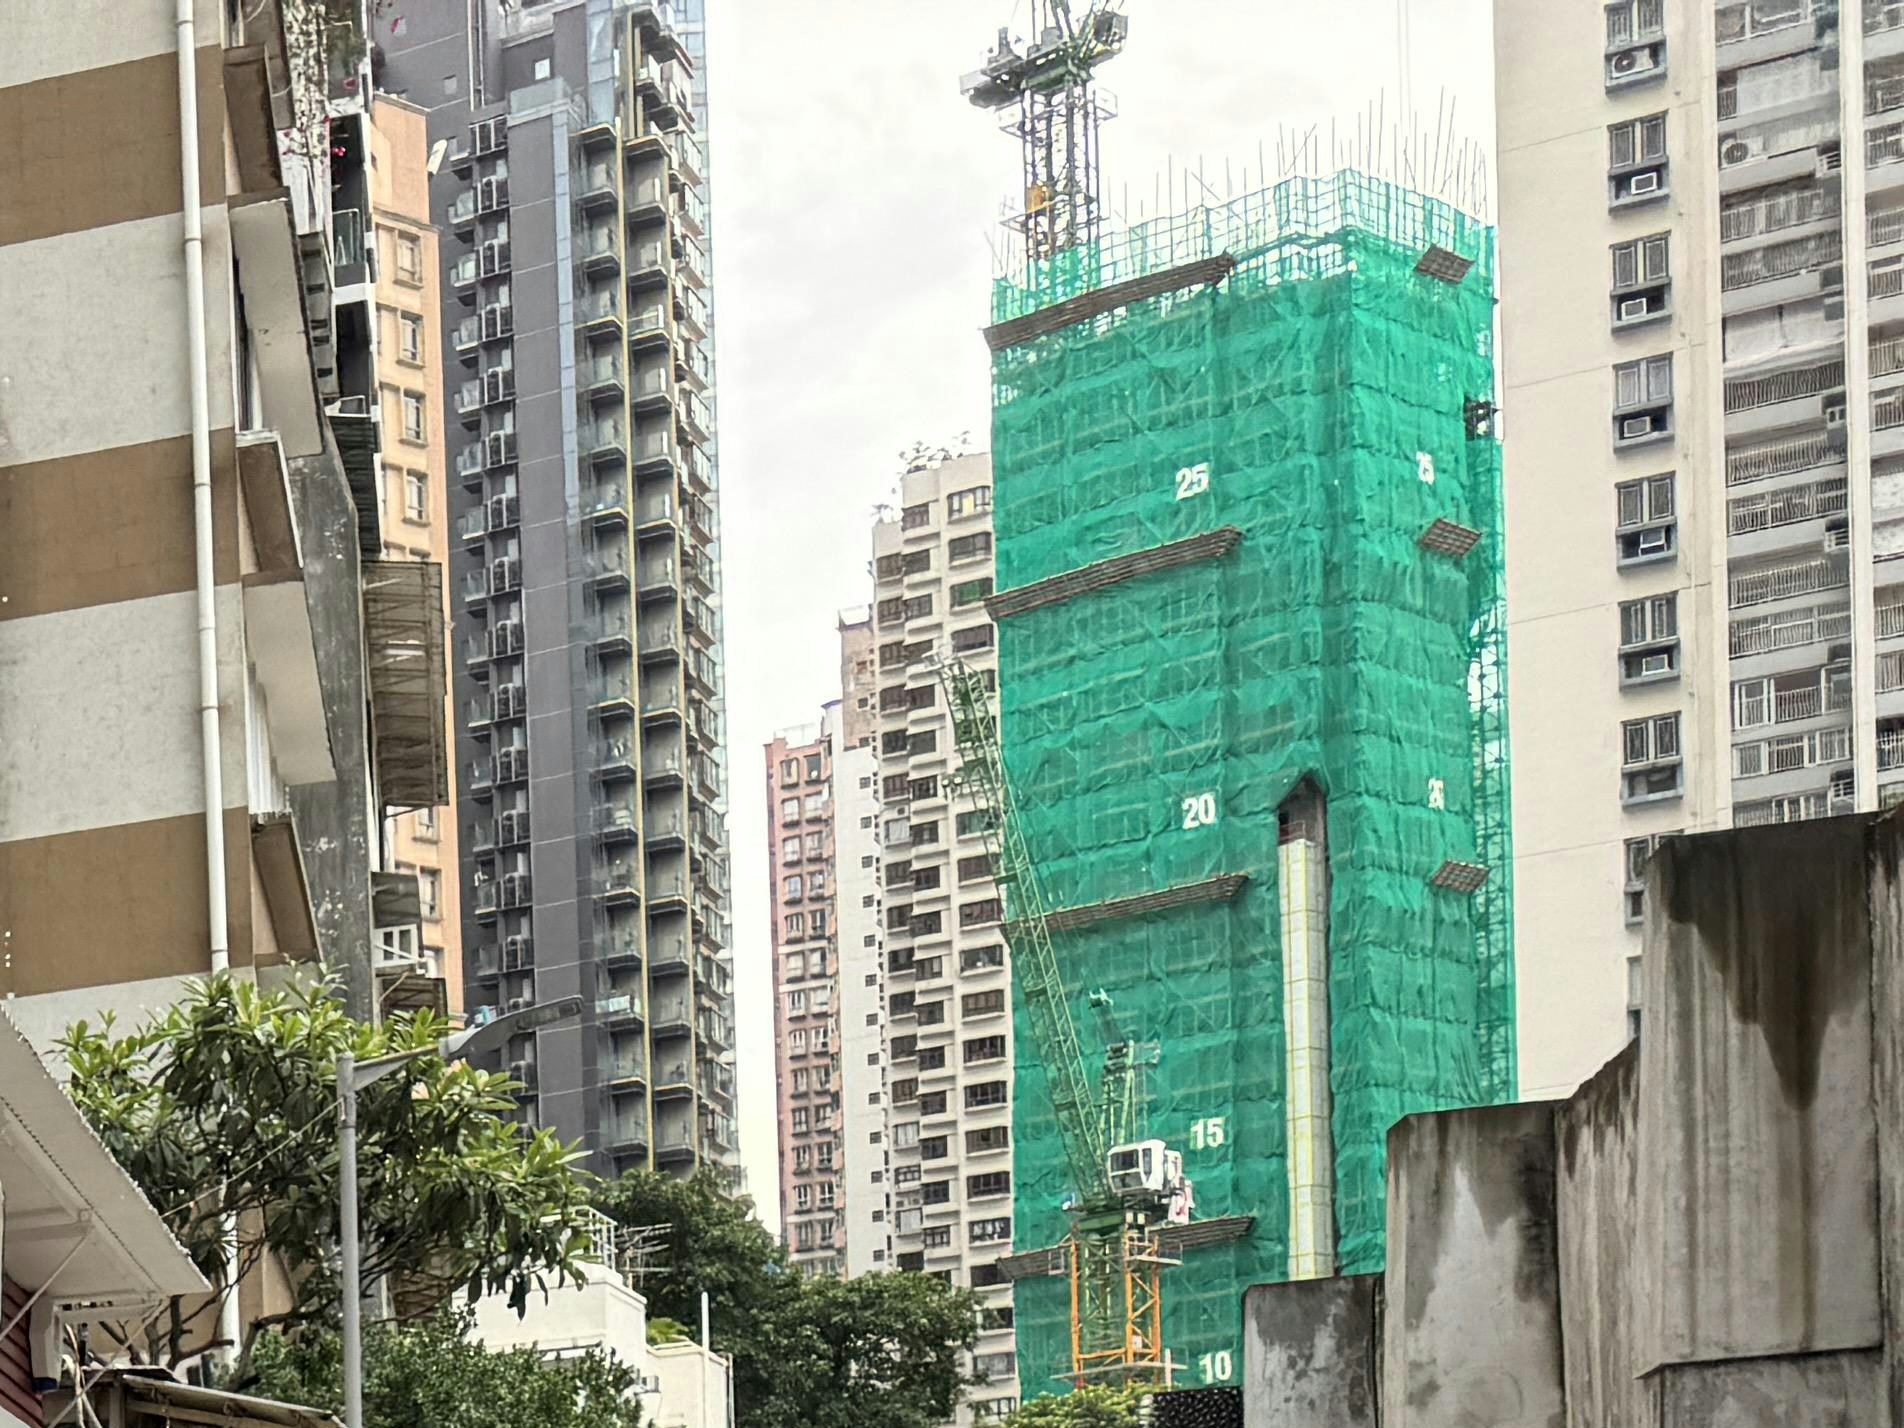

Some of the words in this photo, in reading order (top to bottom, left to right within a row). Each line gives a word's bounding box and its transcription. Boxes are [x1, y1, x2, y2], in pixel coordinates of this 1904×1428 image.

[1176, 462, 1210, 500] 25
[1182, 793, 1216, 830] 20
[1190, 1117, 1225, 1150] 15
[1198, 1351, 1232, 1384] 10
